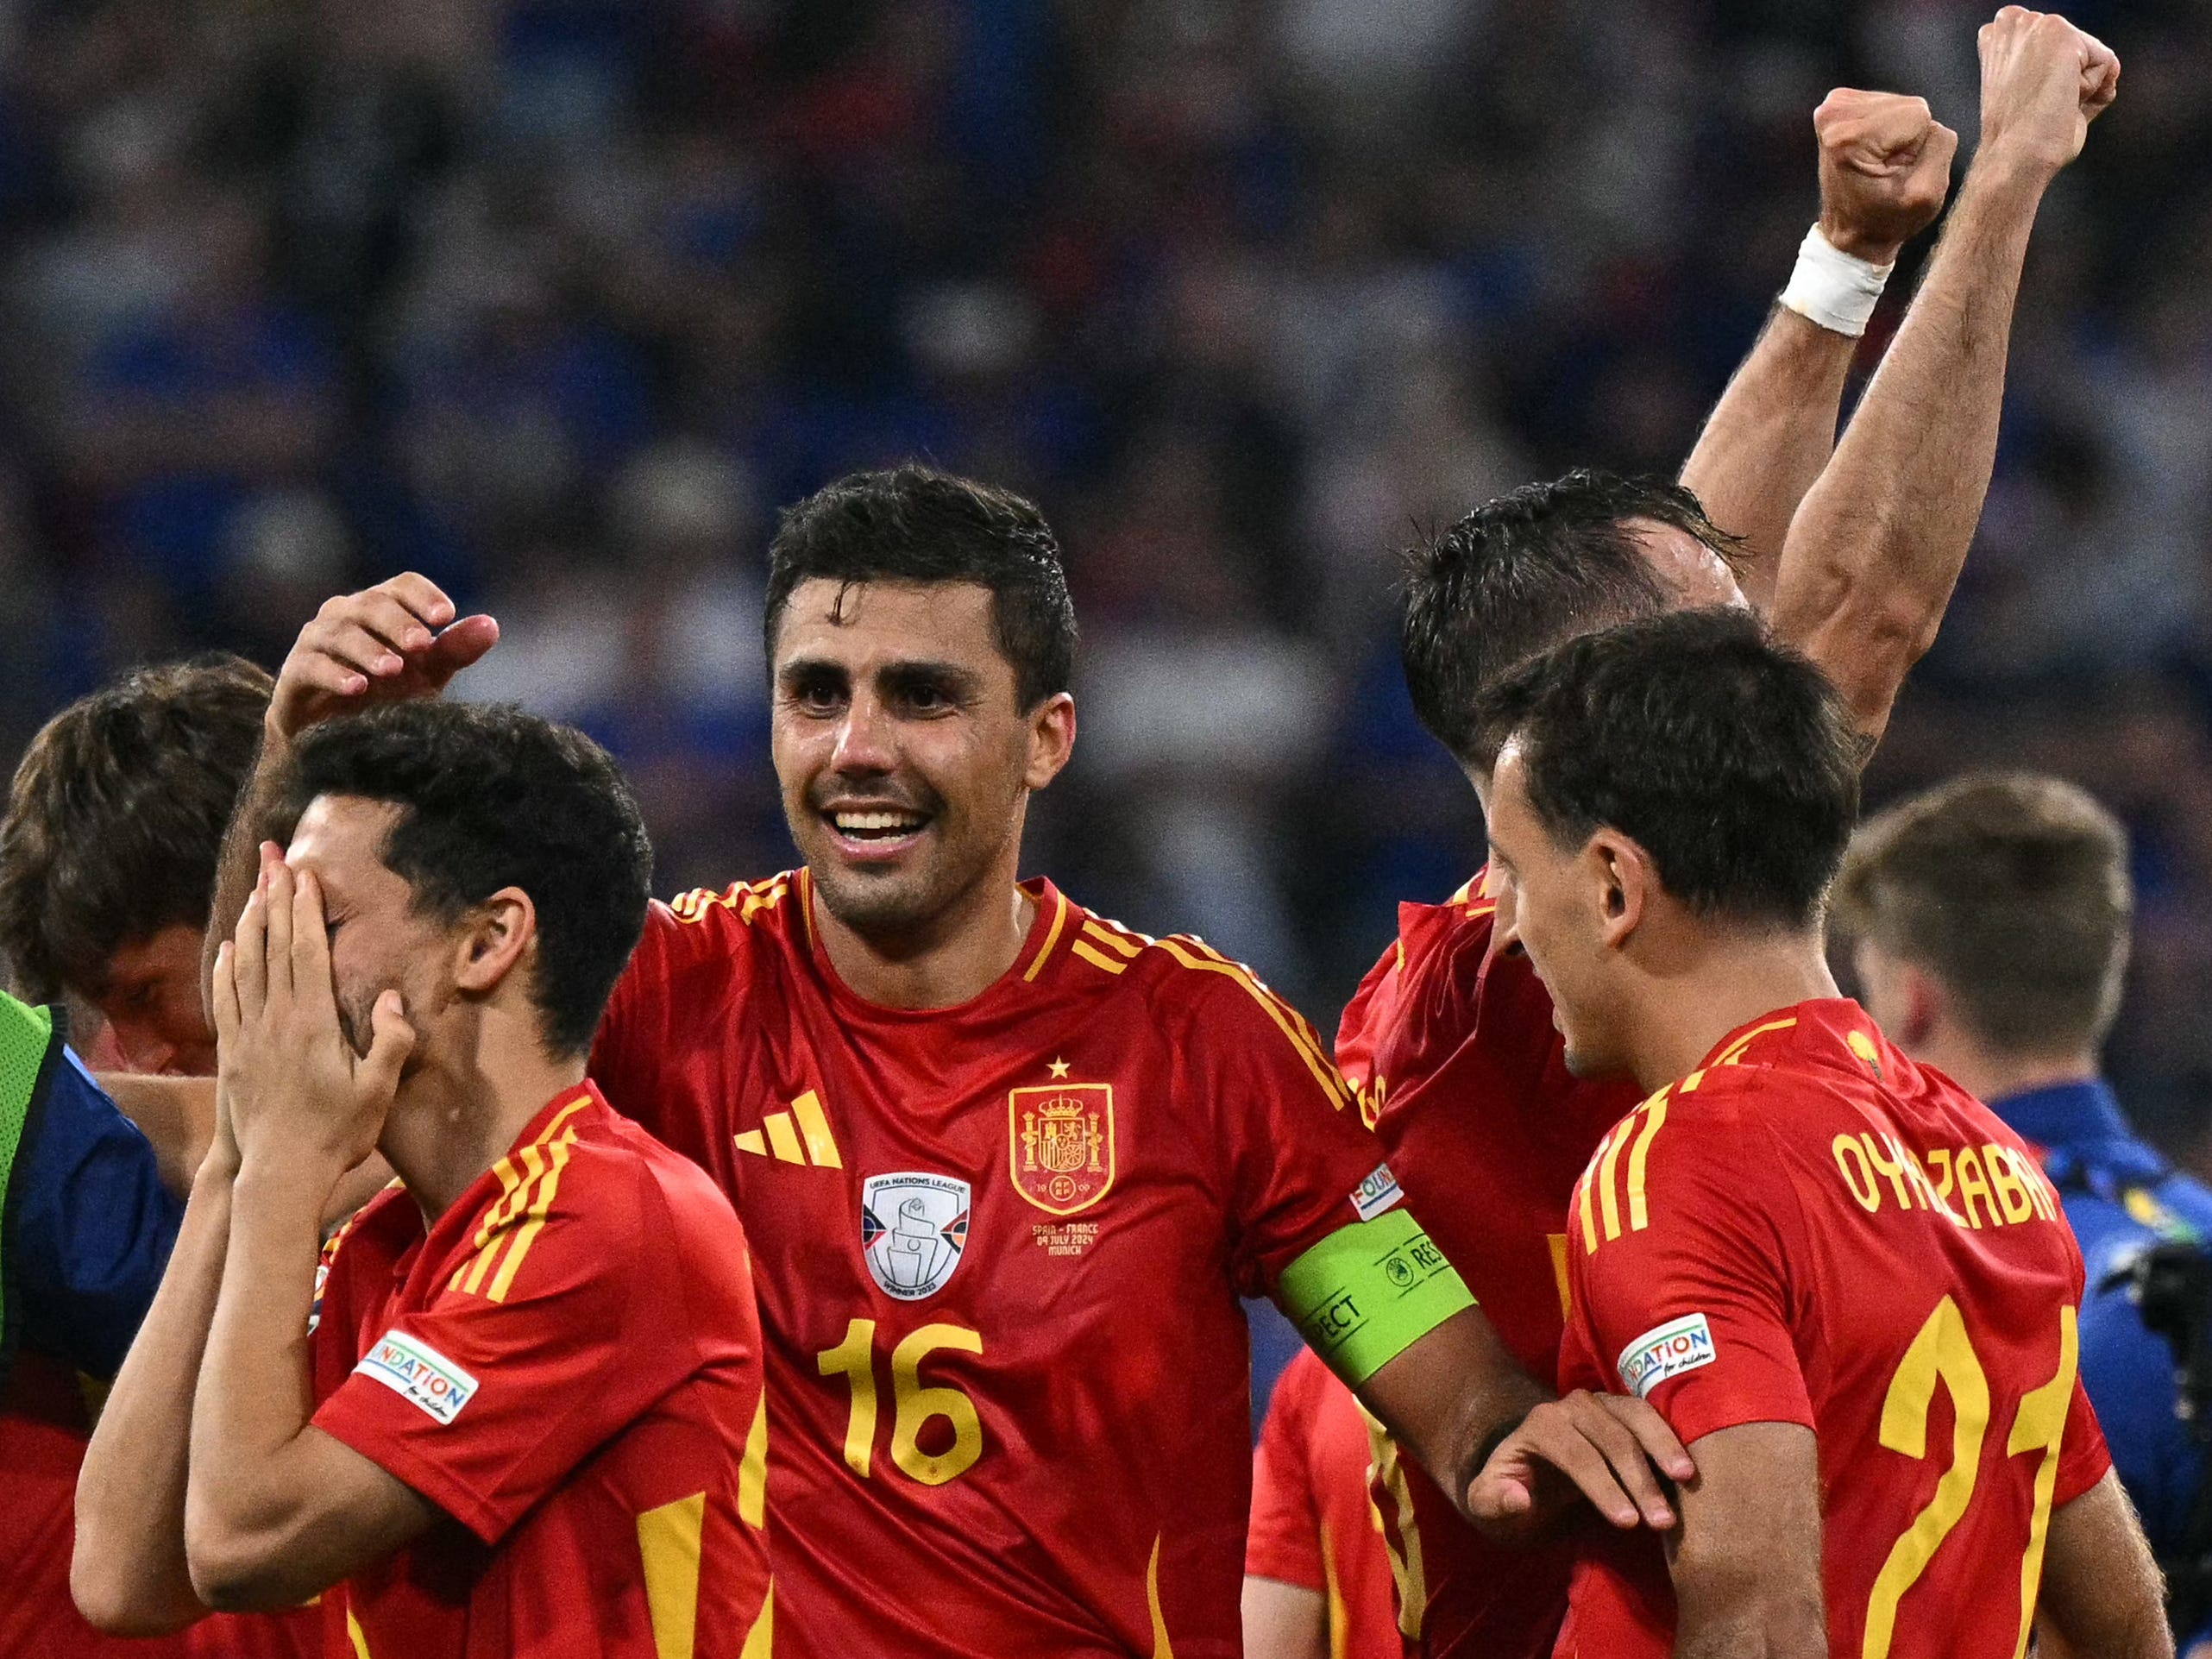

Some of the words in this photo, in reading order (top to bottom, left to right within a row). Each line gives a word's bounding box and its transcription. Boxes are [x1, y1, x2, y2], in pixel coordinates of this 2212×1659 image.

[870, 1179, 890, 1189] UEFA
[892, 1177, 930, 1185] NATIONS
[932, 1179, 966, 1194] LEAGUE
[1032, 1225, 1057, 1235] SPAIN
[1066, 1223, 1099, 1235] FRANCE
[1050, 1235, 1070, 1245] JULY
[1071, 1235, 1094, 1246] 2024
[1048, 1245, 1082, 1256] MUNICH
[884, 1280, 915, 1297] WINNER
[1663, 1362, 1675, 1378] for
[1678, 1353, 1711, 1368] children
[817, 1318, 983, 1486] 16
[1862, 1293, 2078, 1659] 21
